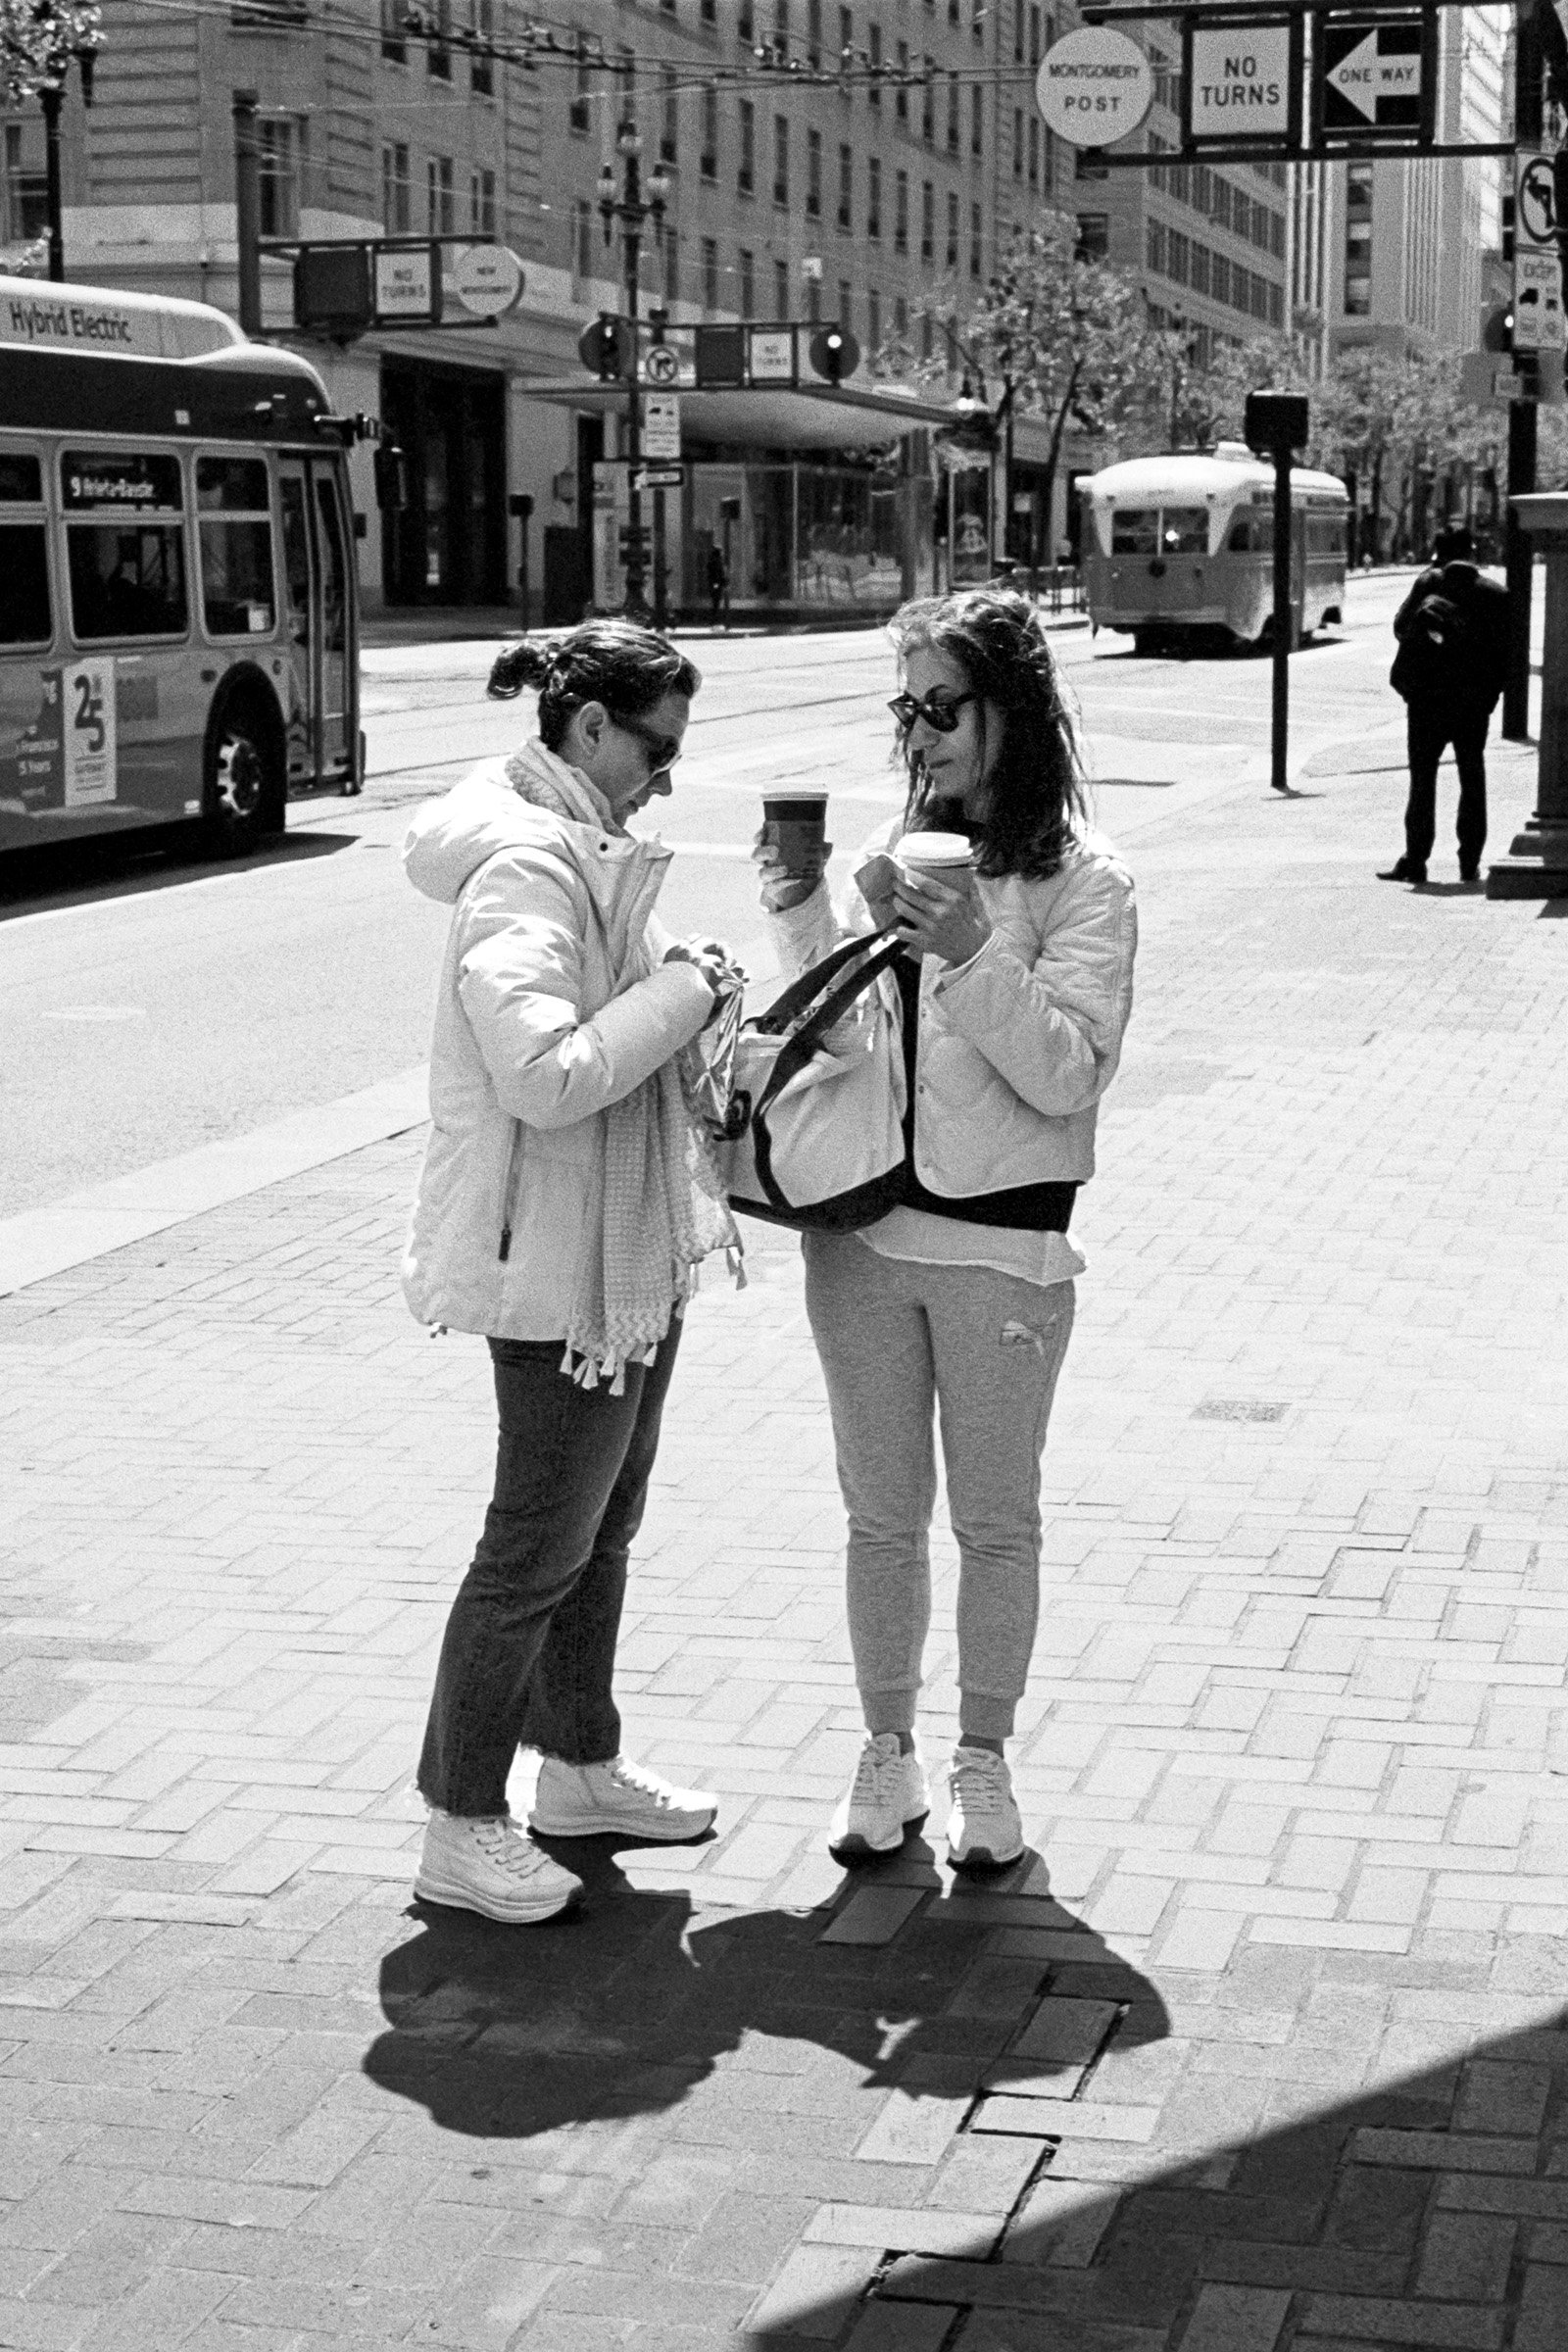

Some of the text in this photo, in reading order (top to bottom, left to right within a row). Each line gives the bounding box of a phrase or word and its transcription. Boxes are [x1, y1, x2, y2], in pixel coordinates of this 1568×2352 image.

[1049, 63, 1140, 78] MONTGOMERY
[1225, 56, 1256, 77] NO
[1339, 66, 1414, 83] ONE WAY
[1064, 96, 1121, 112] POST
[1200, 84, 1281, 107] TURNS
[9, 302, 132, 343] Hybrid Electric
